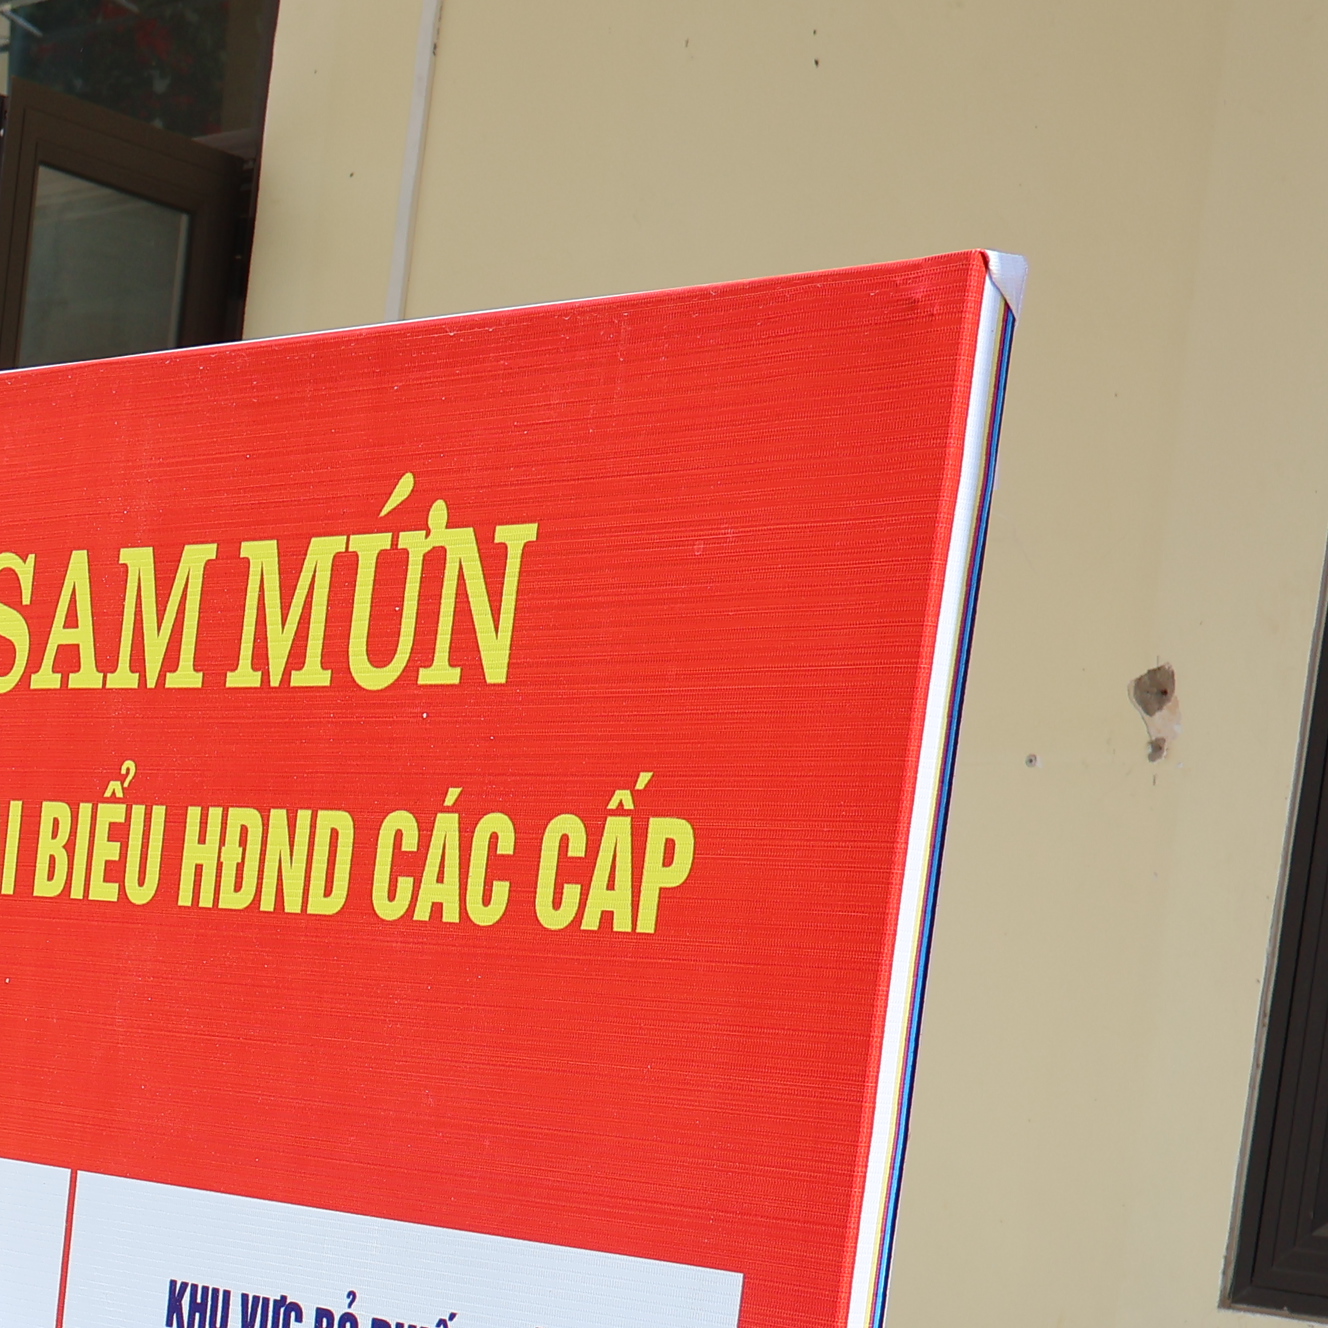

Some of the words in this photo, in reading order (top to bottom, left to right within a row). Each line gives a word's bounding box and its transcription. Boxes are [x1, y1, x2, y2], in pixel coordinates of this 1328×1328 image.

[226, 473, 538, 690] MỨN
[33, 760, 166, 905] BIỂU
[178, 806, 354, 915] HĐND
[372, 788, 515, 926] CÁC
[536, 772, 694, 933] CẤP
